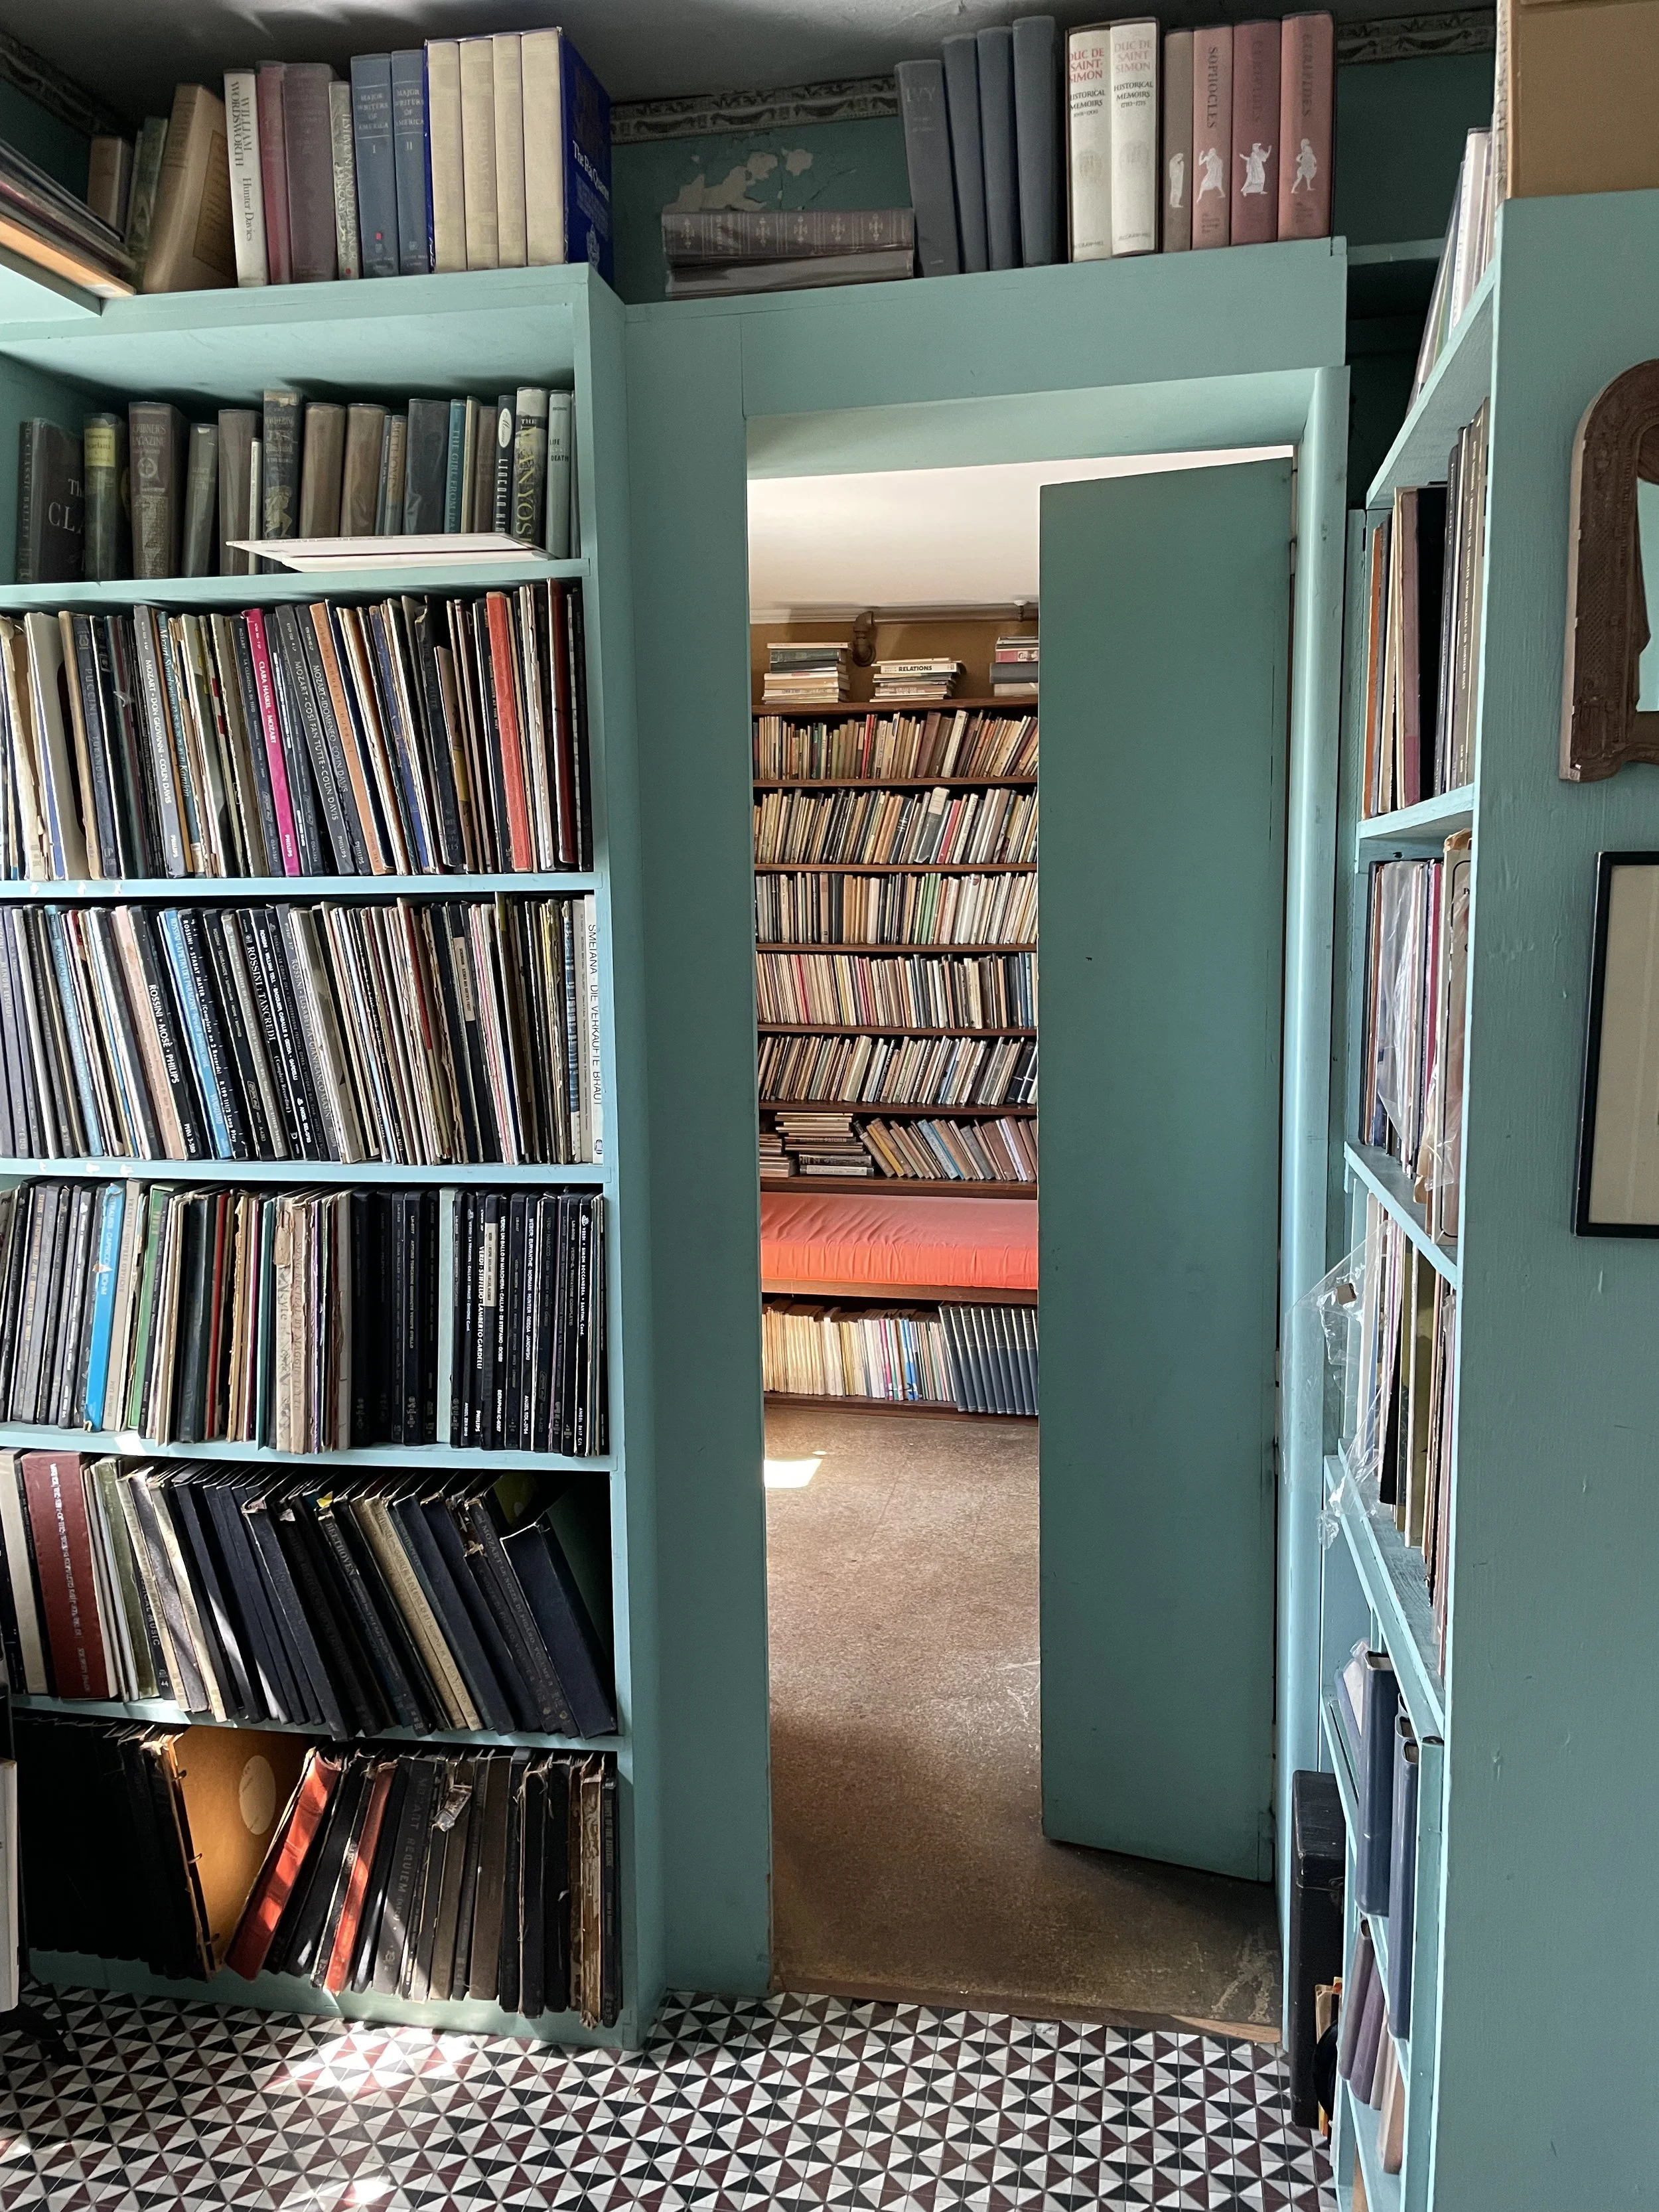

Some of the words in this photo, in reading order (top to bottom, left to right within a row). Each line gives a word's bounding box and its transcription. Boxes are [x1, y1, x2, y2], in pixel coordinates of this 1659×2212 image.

[1091, 48, 1104, 58] DE
[1115, 41, 1137, 52] DUC
[1139, 40, 1153, 49] DE
[1116, 62, 1151, 72] SIMON
[1114, 81, 1154, 92] HISTORICAL
[1116, 91, 1151, 101] MEMOIRS
[1206, 46, 1219, 129] SOPHOCLES
[1070, 99, 1103, 110] MEMOIRS
[231, 81, 244, 166] WORDSWORTH
[241, 97, 252, 151] WILLIAM
[573, 140, 584, 167] The
[243, 177, 252, 210] Hunter
[245, 212, 255, 242] Davies
[449, 453, 460, 478] GIRL
[144, 659, 155, 692] MOZART
[257, 660, 267, 684] CLARA
[294, 660, 309, 696] MOZART
[84, 667, 98, 715] PUCCINI
[261, 685, 271, 709] HASKIL
[149, 698, 159, 716] DON
[159, 627, 171, 656] Mozart
[178, 764, 191, 797] Karajan
[152, 717, 164, 753] GIOVANNI
[265, 714, 277, 743] MOZART
[309, 723, 320, 739] FAN
[311, 664, 326, 697] MOZART
[320, 700, 336, 742] IDOMENEO
[330, 745, 342, 769] COLIN
[336, 769, 348, 792] DAVIS
[354, 840, 364, 865] PHILIPS
[313, 739, 326, 765] TUTTE
[158, 758, 168, 781] COLIN
[161, 782, 171, 804] DAVIS
[321, 770, 333, 796] COLIN
[326, 796, 338, 820] DAVIS
[169, 834, 179, 857] PHILIPS
[283, 834, 293, 857] PHILIPS
[336, 835, 346, 858] PHILIPS
[182, 919, 193, 945] ROSSINI
[53, 945, 66, 976] RAMEAU
[259, 929, 267, 948] ROSSINI
[264, 952, 273, 971] WILLIAM
[0, 961, 9, 989] MANON
[189, 952, 200, 975] STABAT
[194, 976, 205, 996] MATER
[589, 984, 598, 1002] DIE
[169, 917, 181, 941] ROSSINI
[177, 948, 187, 969] PIETRA
[184, 980, 197, 1011] PARAGONE
[210, 1092, 223, 1124] VANGUARD
[200, 1003, 214, 1033] (Complete
[147, 984, 164, 1017] ROSSINI
[157, 1022, 173, 1047] MOSÈ
[165, 1053, 180, 1084] PHILIPS
[257, 992, 276, 1041] TANCREDI
[273, 1055, 284, 1083] (Complete
[291, 958, 303, 990] ROSSINI
[299, 995, 314, 1037] ELISABETTA
[309, 1041, 326, 1092] GIANFRANCO
[319, 1092, 332, 1120] MASINI
[210, 1049, 223, 1074] Records)
[225, 1114, 234, 1129] Long
[228, 1129, 238, 1143] Play
[119, 1263, 127, 1292] RICHARD
[125, 1197, 134, 1226] ELEKTRA
[294, 1242, 303, 1269] SONG
[294, 1273, 303, 1314] RECITAL
[294, 1319, 302, 1331] BY
[325, 1520, 356, 1576] BEETHOVEN
[145, 1613, 161, 1646] MUSIC
[397, 1837, 415, 1892] REQUIEM
